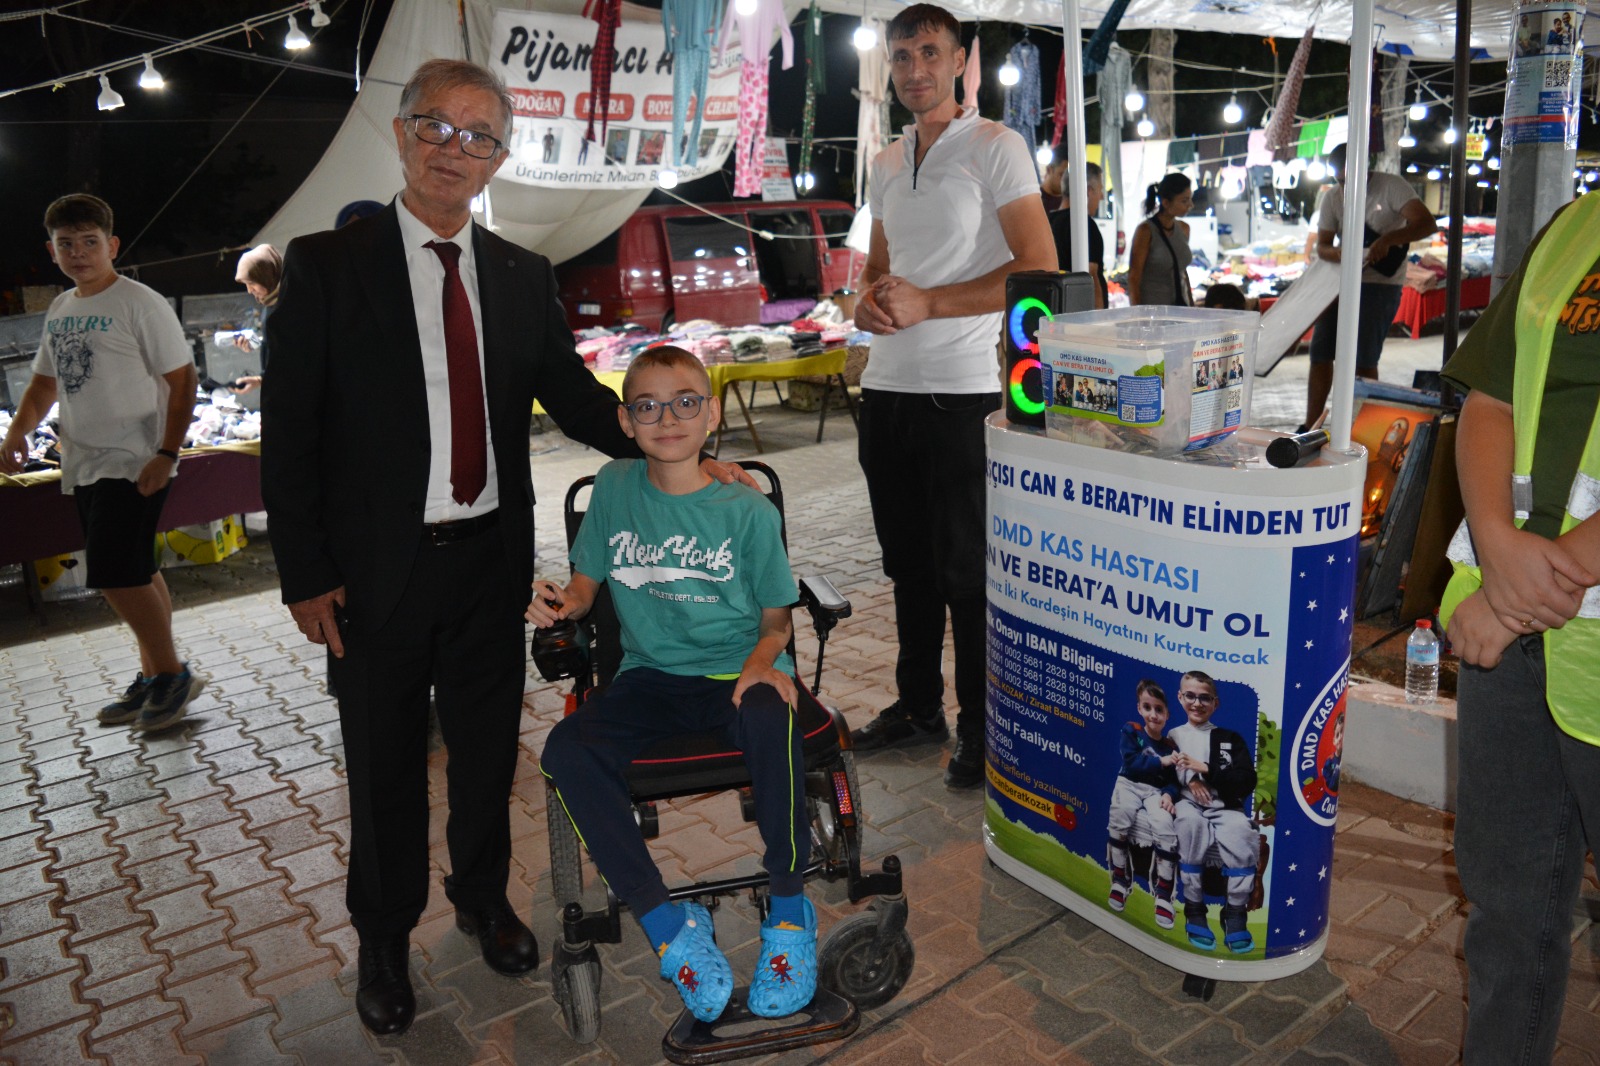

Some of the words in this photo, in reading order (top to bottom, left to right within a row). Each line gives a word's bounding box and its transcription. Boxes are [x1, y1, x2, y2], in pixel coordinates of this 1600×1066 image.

[501, 26, 648, 82] Pijamcı
[515, 163, 604, 184] Ürünlerimiz
[1020, 469, 1056, 497] CAN
[1063, 478, 1075, 501] &
[1183, 500, 1303, 535] ELİNDEN
[1313, 502, 1350, 532] TUT
[608, 530, 665, 566] New
[663, 534, 733, 571] York
[993, 514, 1033, 547] DMD
[1040, 530, 1083, 562] KAS
[1091, 544, 1199, 593] HASTASI
[675, 594, 693, 602] DEPT.
[1000, 549, 1021, 578] VE
[1127, 590, 1213, 632] UMUT
[1224, 612, 1270, 637] OL
[995, 618, 1023, 645] Onayı
[1026, 632, 1058, 657] IBAN
[1061, 645, 1114, 679] Bilgileri
[1005, 579, 1017, 600] İki
[1021, 589, 1079, 621] Kardeşin
[1084, 611, 1148, 644] Hayatını
[1154, 633, 1269, 665] Kurtaracak
[1004, 645, 1021, 660] 0002
[1023, 654, 1042, 670] 5681
[1046, 662, 1066, 679] 2828
[1069, 672, 1091, 689] 9150
[1093, 681, 1105, 694] 03
[1004, 658, 1021, 674] 0002
[1023, 668, 1042, 683] 5681
[1046, 676, 1066, 692] 2828
[1069, 685, 1091, 702] 9150
[1093, 695, 1105, 709] 04
[1001, 683, 1024, 701] KOZAK
[1030, 696, 1052, 713] Ziraat
[1053, 706, 1085, 727] Bankası
[1004, 672, 1021, 687] 0002
[1023, 681, 1042, 697] 5681
[1046, 690, 1066, 706] 2828
[1069, 699, 1091, 716] 9150
[1092, 709, 1105, 722] 05
[995, 706, 1011, 732] İzni
[1013, 722, 1061, 755] Faaliyet
[1064, 744, 1086, 767] No:
[998, 747, 1019, 766] KOZAK
[1302, 732, 1319, 771] DMD
[1313, 698, 1335, 730] KAS
